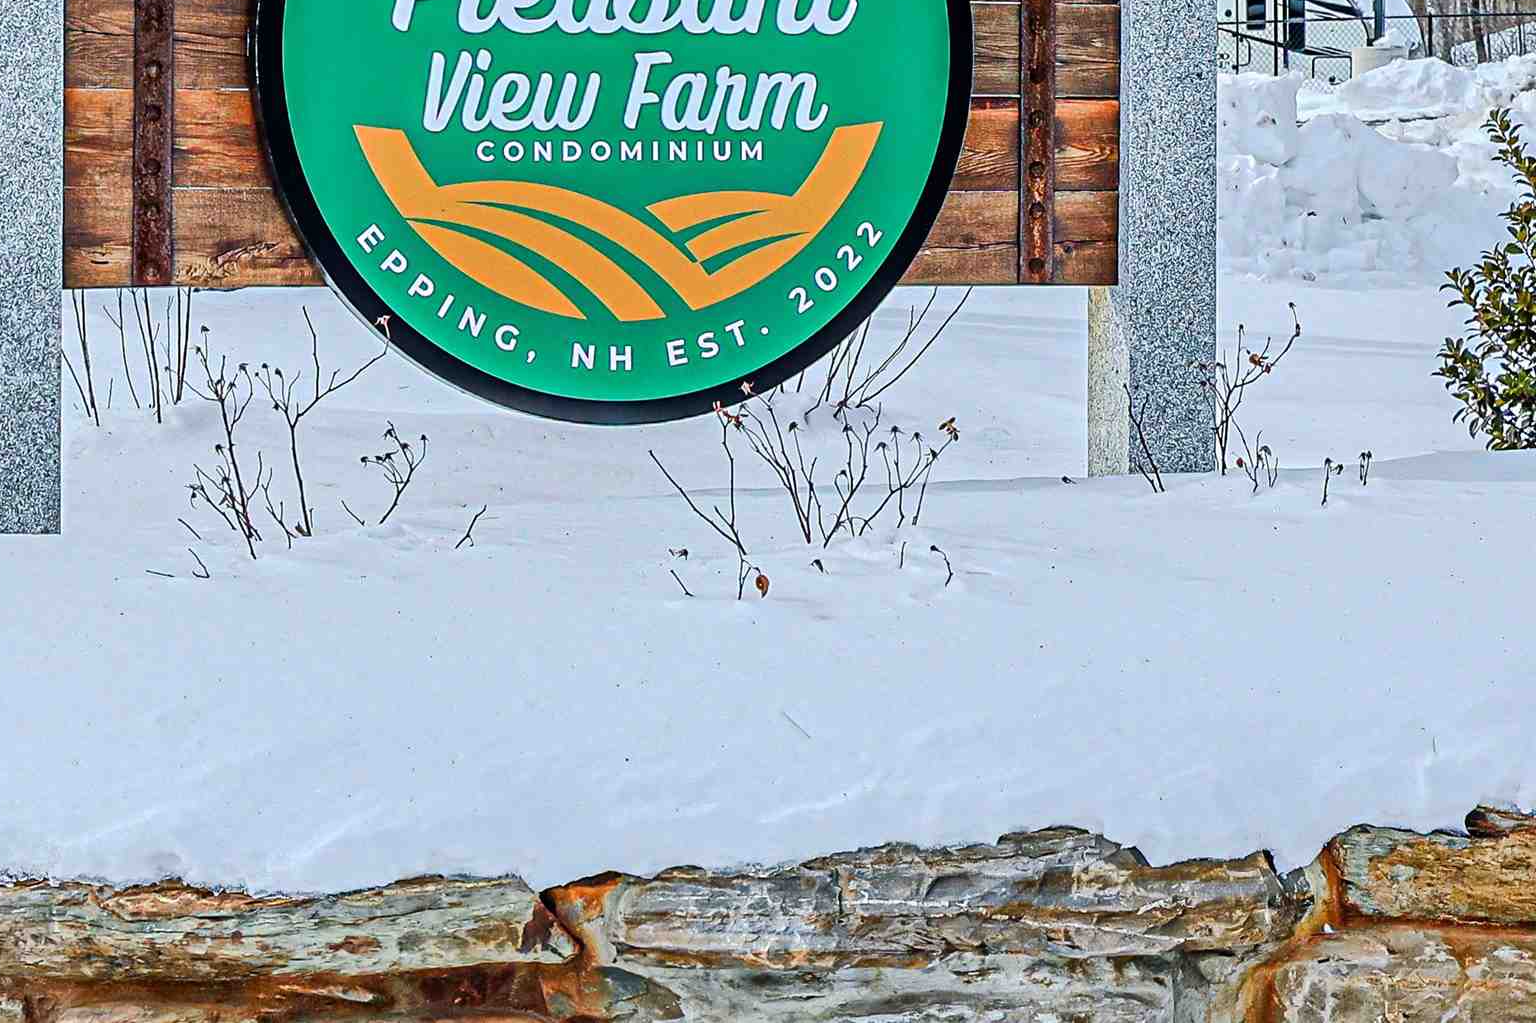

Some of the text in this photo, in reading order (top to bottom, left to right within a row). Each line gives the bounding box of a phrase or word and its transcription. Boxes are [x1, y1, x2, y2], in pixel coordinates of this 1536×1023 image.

[422, 48, 828, 135] View Farm
[476, 139, 765, 163] CONDOMINIUM
[356, 220, 885, 371] EPPING, NH EST. 2022
